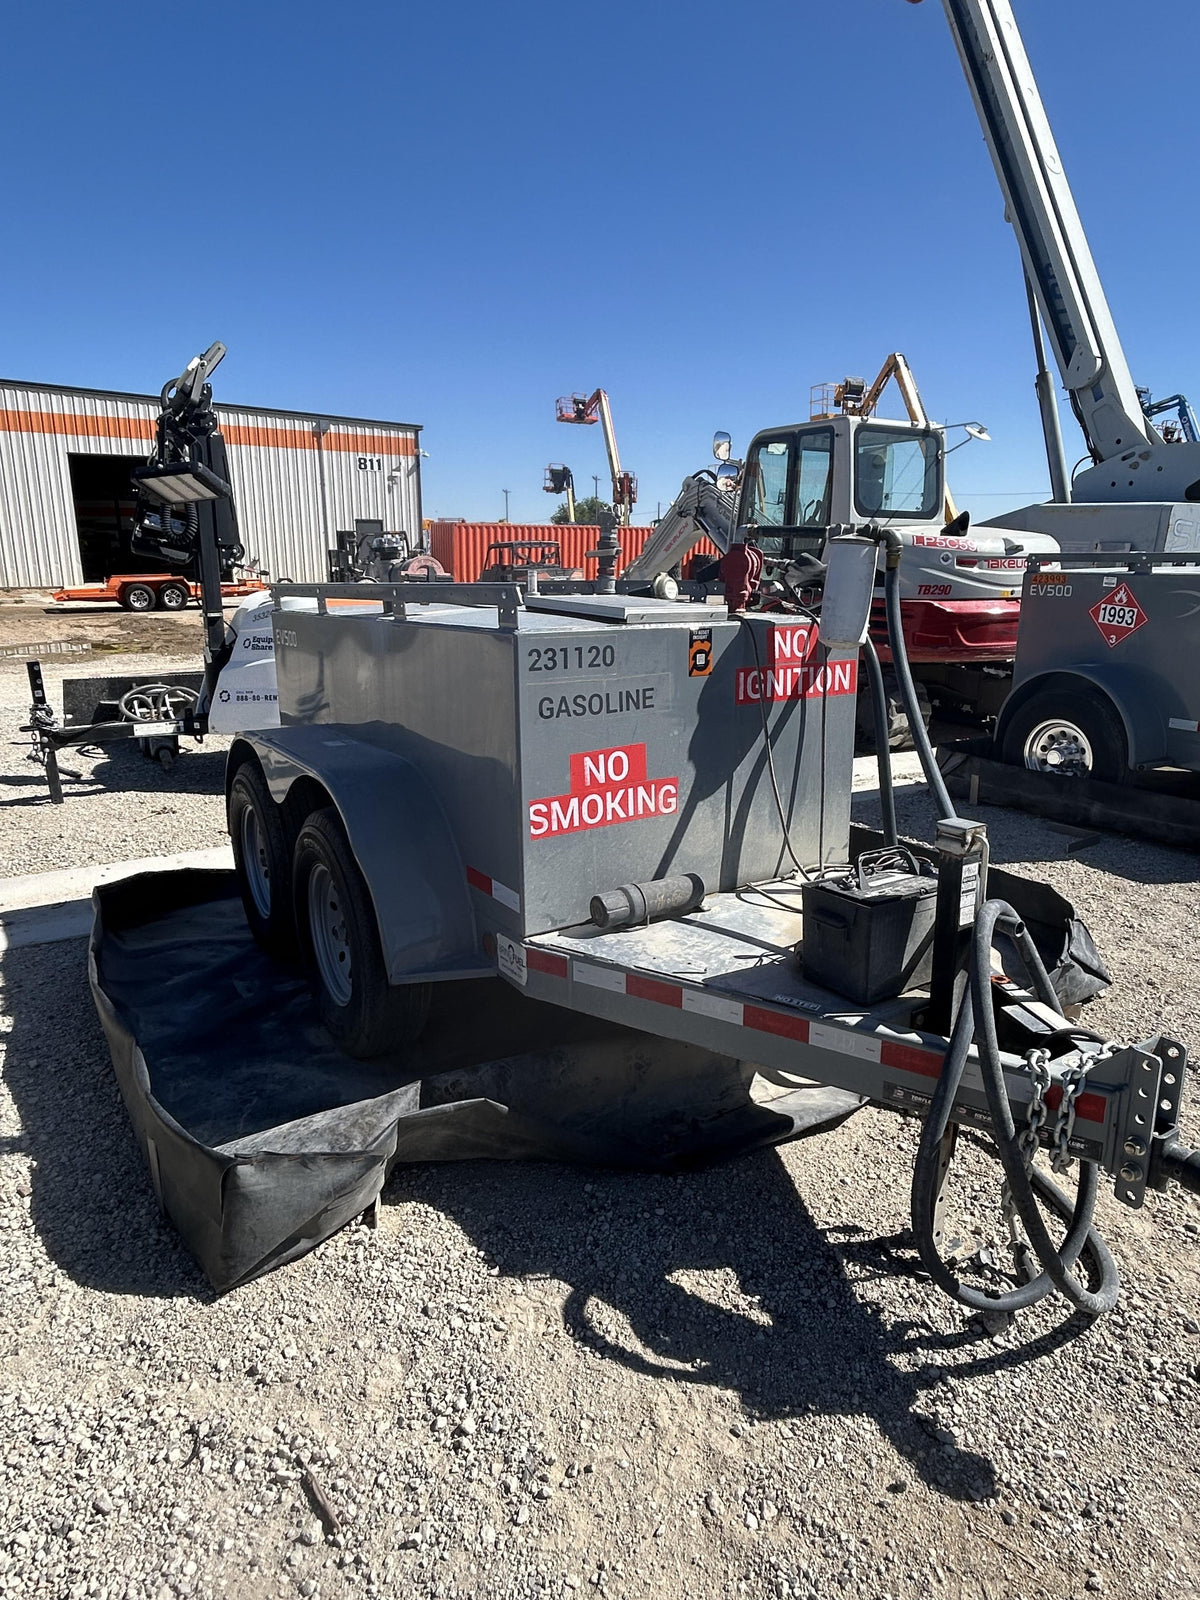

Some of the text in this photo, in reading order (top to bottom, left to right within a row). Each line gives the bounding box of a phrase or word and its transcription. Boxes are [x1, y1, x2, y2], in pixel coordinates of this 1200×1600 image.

[358, 457, 381, 470] 811
[912, 535, 978, 551] LP5C59
[1032, 575, 1067, 583] 423993
[917, 584, 952, 595] TB290
[1029, 584, 1073, 597] EV500
[1101, 605, 1135, 626] 1993
[251, 643, 273, 651] Share
[774, 629, 810, 659] NO
[1109, 635, 1117, 644] 3
[527, 644, 616, 672] 231120
[738, 663, 851, 701] IGNITION
[538, 687, 655, 720] GASOLINE
[583, 750, 630, 787] NO
[529, 783, 677, 836] SMOKING
